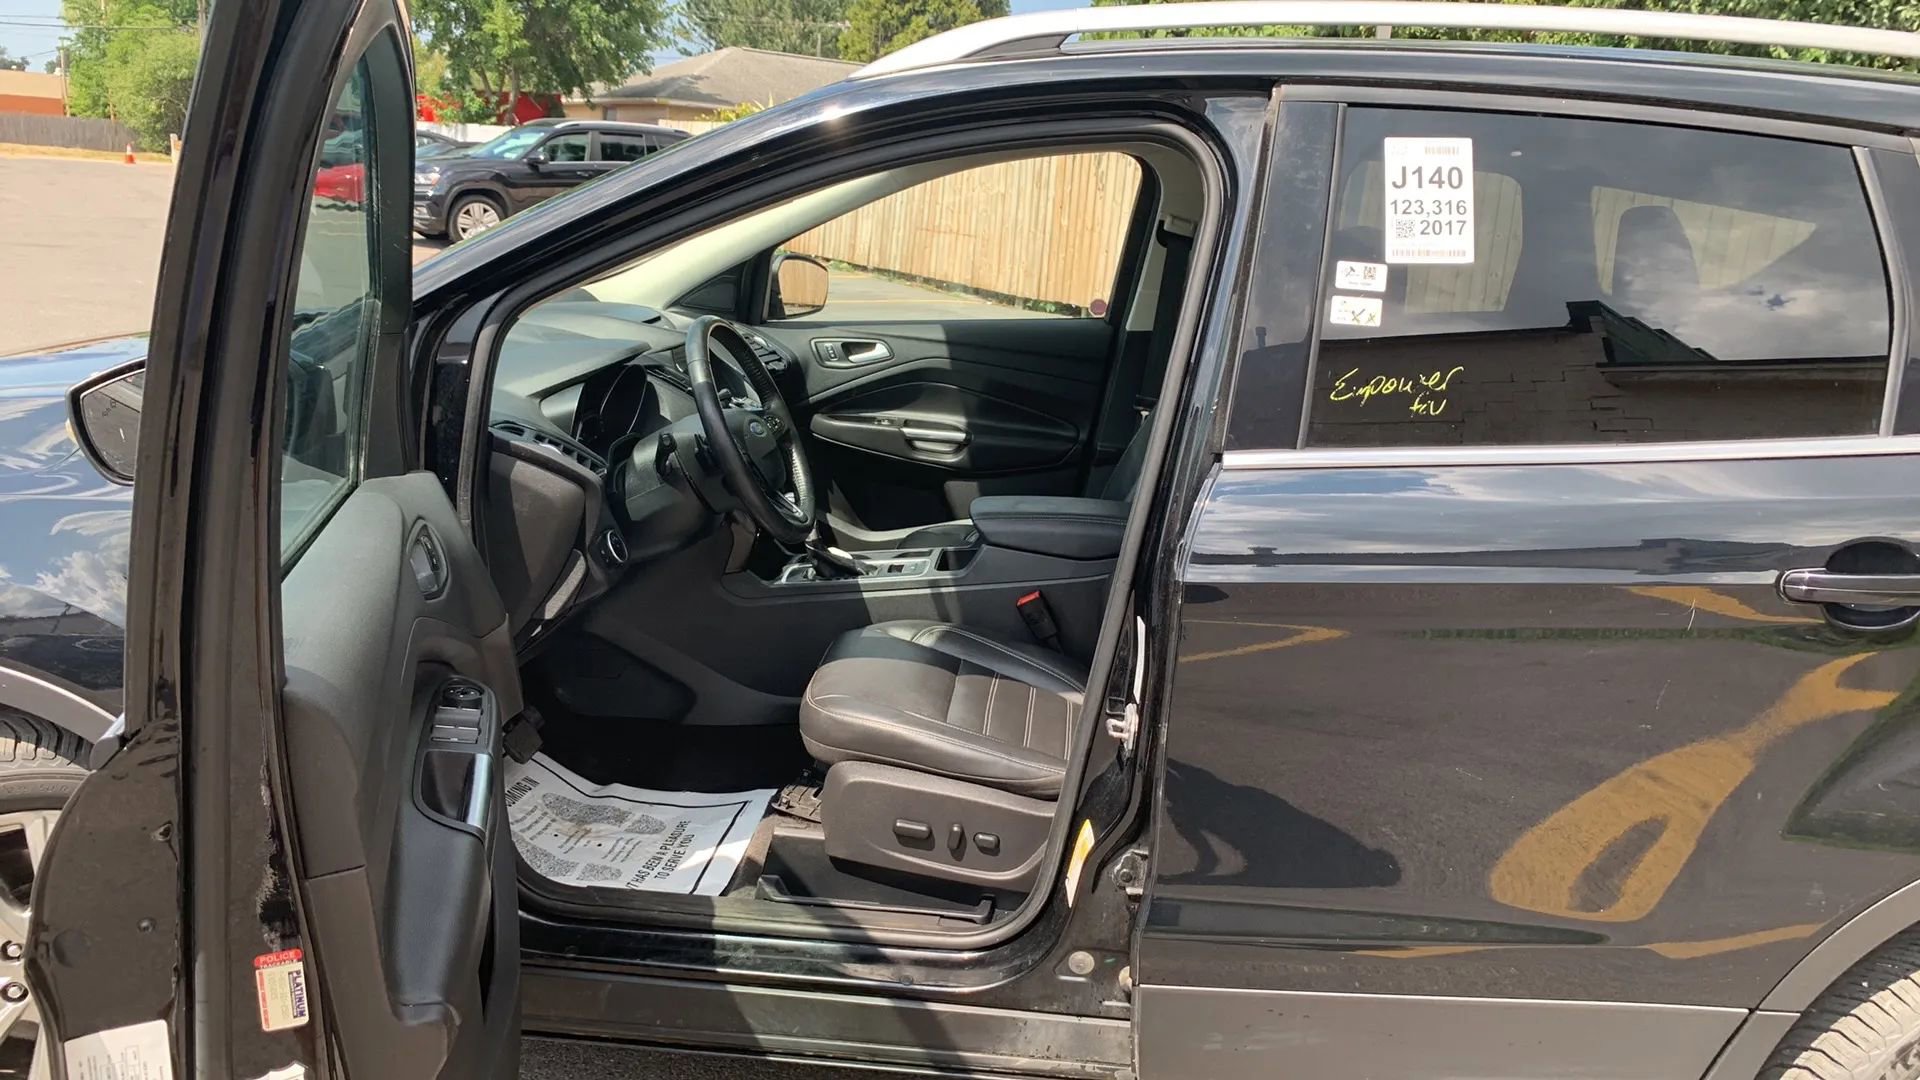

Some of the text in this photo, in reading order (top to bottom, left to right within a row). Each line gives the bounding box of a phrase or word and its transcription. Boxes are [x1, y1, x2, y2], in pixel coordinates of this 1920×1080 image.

[1391, 165, 1463, 189] J140
[1390, 199, 1467, 218] 123,316
[1420, 219, 1467, 236] 2017
[631, 869, 651, 884] HAS
[642, 855, 664, 872] BEEN
[659, 820, 692, 851] PLEASURE
[654, 834, 695, 880] TO SERVE YOU
[260, 953, 296, 964] POLICE
[293, 969, 307, 1018] PLATINUM
